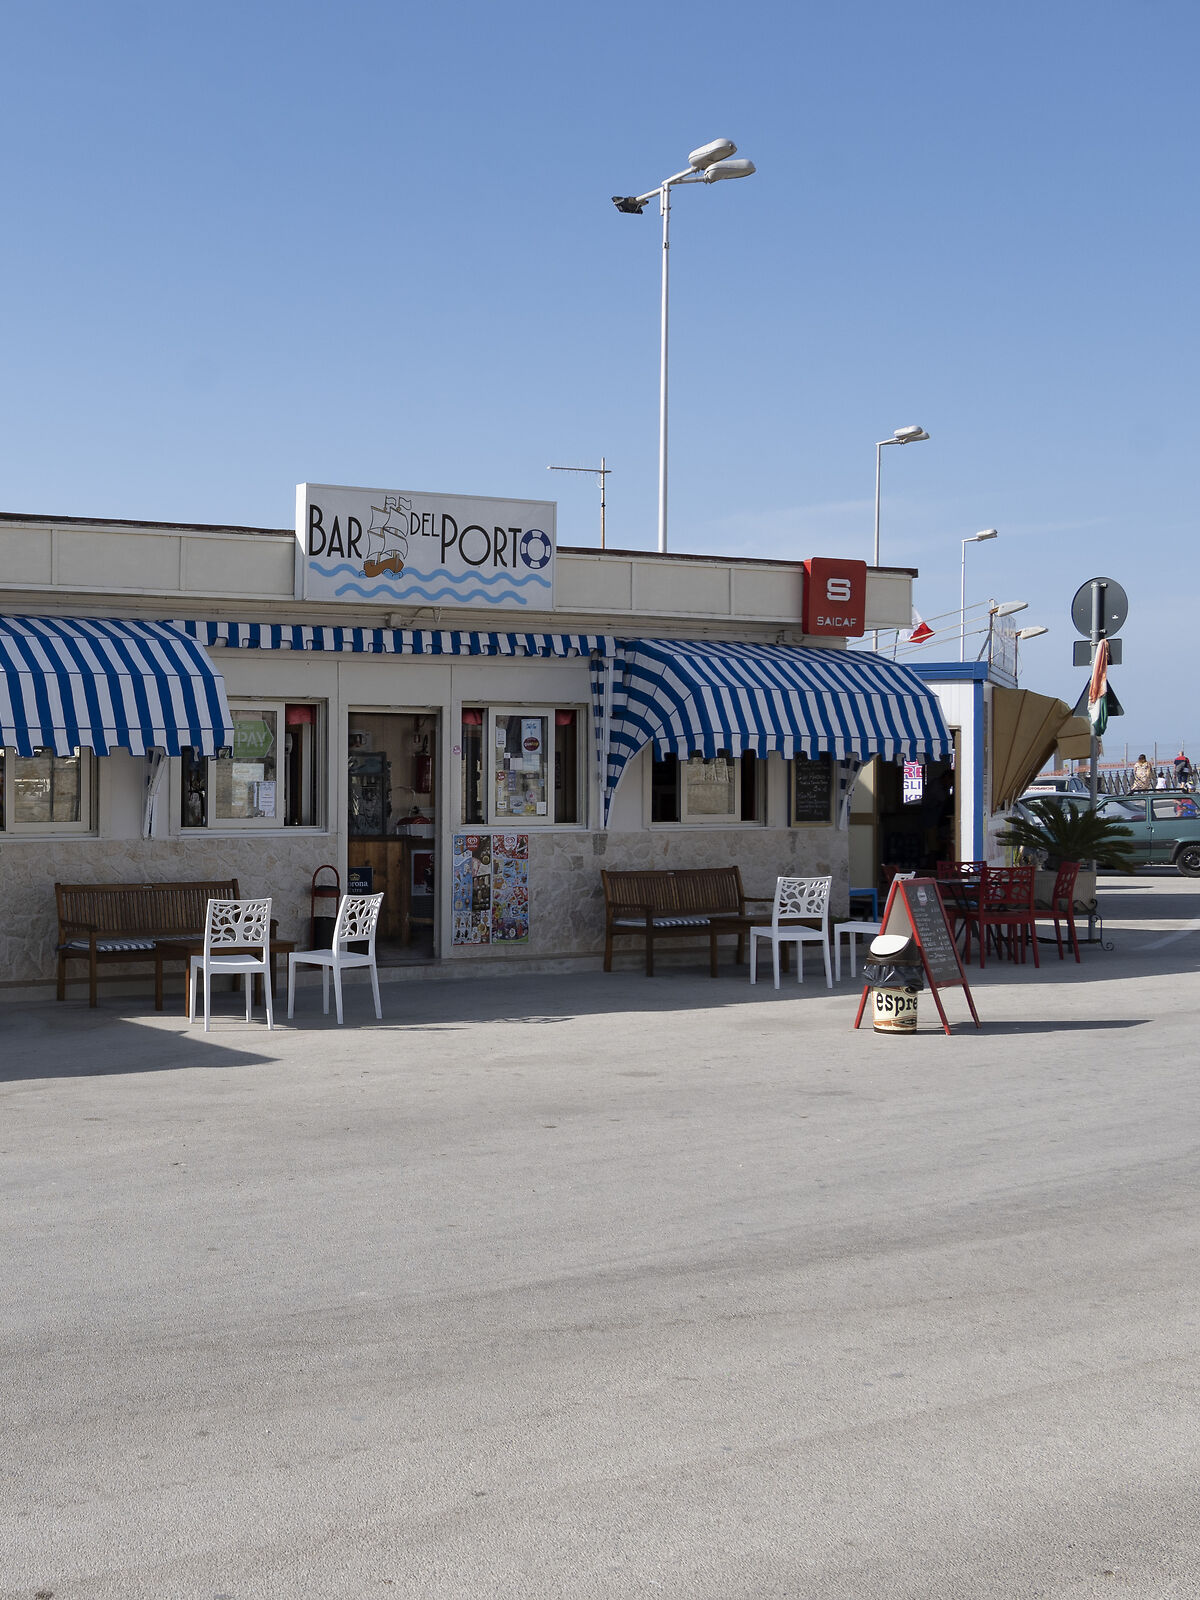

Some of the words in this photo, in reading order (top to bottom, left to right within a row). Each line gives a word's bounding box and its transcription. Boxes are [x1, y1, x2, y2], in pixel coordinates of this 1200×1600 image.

[308, 504, 362, 559] BAR
[410, 512, 440, 538] DEL
[440, 513, 551, 569] PORTO
[826, 578, 851, 601] S
[816, 616, 857, 627] SAICAF
[237, 731, 267, 748] PAY
